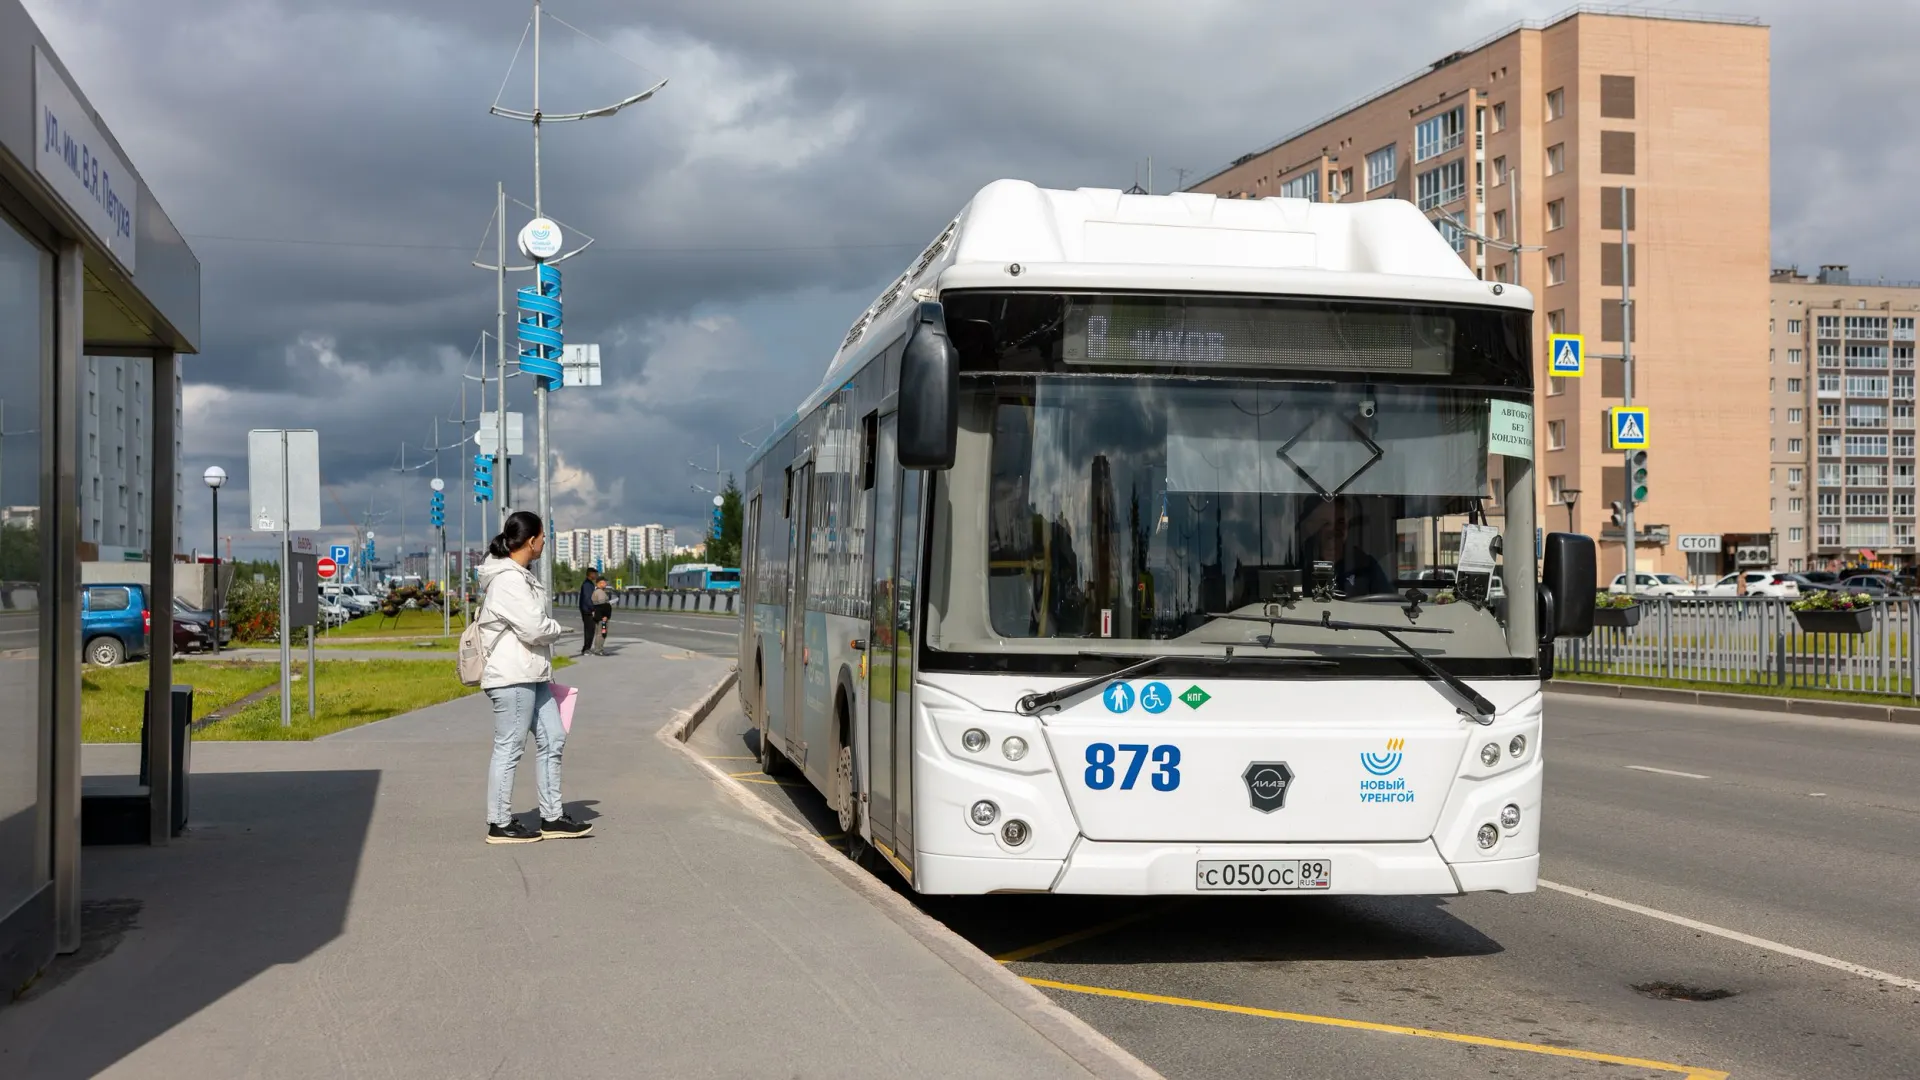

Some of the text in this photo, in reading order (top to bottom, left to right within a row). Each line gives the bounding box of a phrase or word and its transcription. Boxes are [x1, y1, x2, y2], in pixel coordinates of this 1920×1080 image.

[44, 105, 130, 238] ул. им. В.Я. Петуха
[1511, 423, 1525, 432] БЕЗ
[1682, 537, 1716, 548] СТОП
[335, 547, 346, 562] P
[1187, 693, 1202, 701] КПГ
[1084, 742, 1181, 792] 873
[1251, 780, 1286, 788] ЛИАЗ
[1360, 778, 1405, 790] НОВЫЙ
[1360, 790, 1414, 802] УРЕНГОЙ
[1301, 862, 1323, 879] 89
